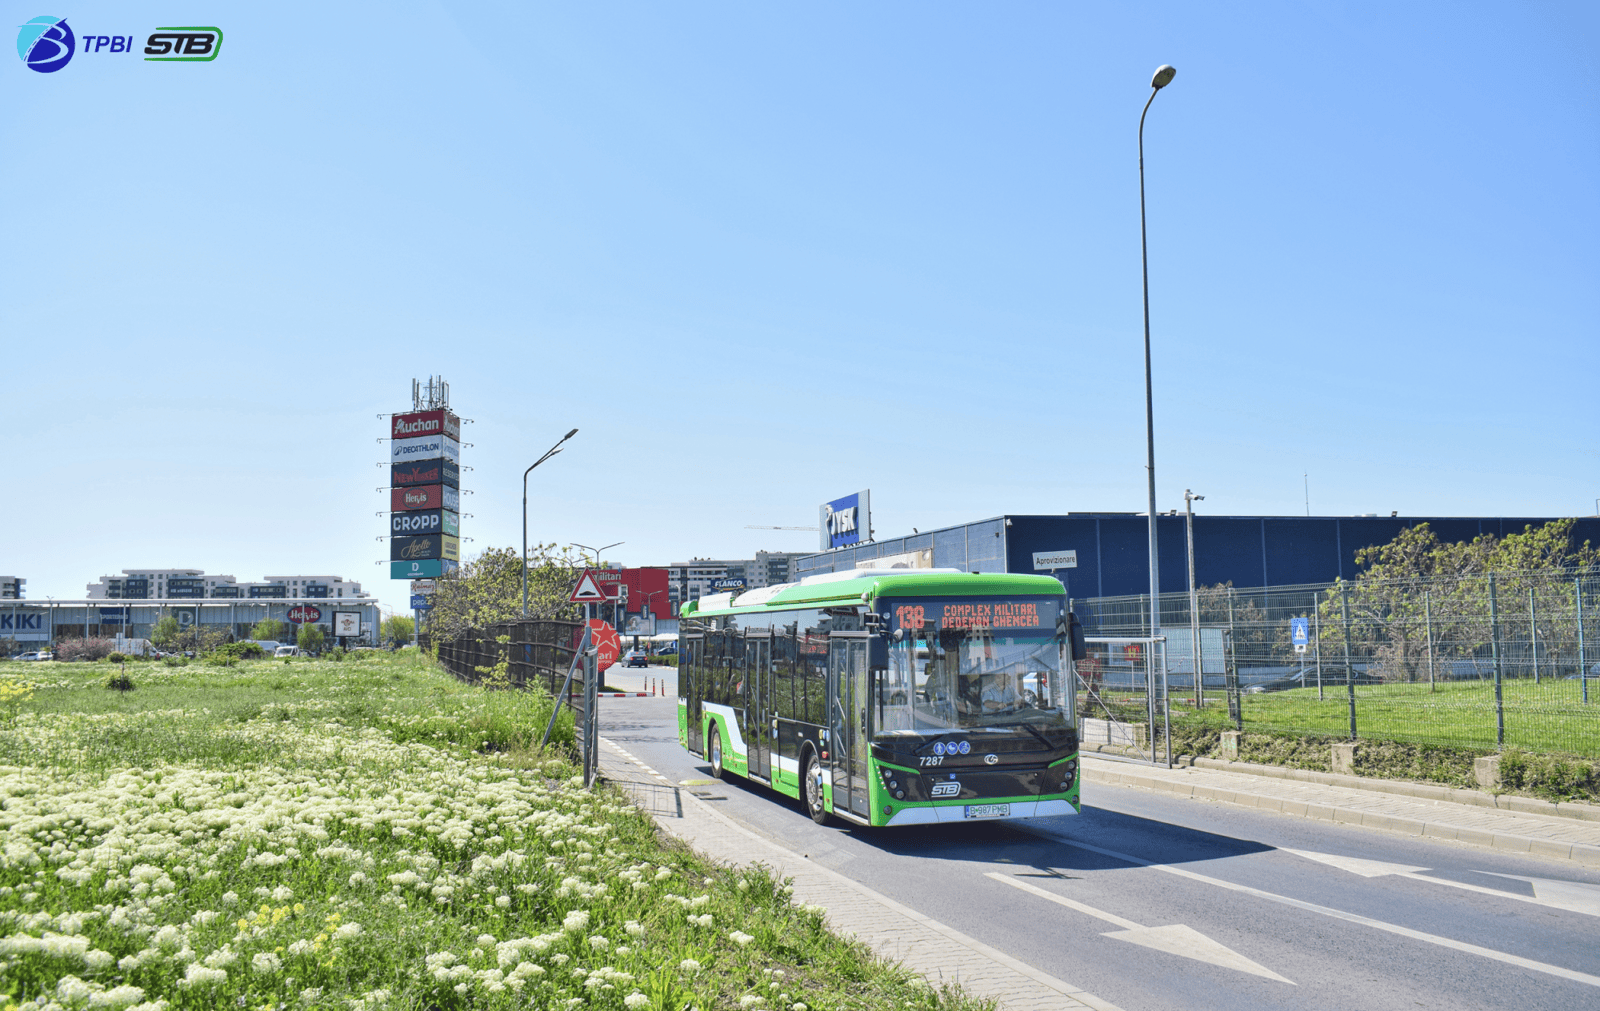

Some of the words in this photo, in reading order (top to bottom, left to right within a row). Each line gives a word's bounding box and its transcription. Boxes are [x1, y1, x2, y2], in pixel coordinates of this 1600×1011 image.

[394, 418, 439, 435] Auchan
[402, 442, 440, 454] DECATHLON
[405, 492, 427, 504] Hervis
[393, 514, 439, 531] CROPP
[831, 506, 857, 535] JYSK
[412, 562, 419, 572] D
[1036, 556, 1076, 566] Aprovizionare
[290, 609, 319, 621] Hervis
[943, 605, 991, 617] COMPLEX
[994, 603, 1037, 616] MILITARI
[896, 605, 925, 629] 138
[941, 616, 990, 629] DEDEMAN
[993, 615, 1039, 627] GHENCEA
[920, 756, 944, 766] 7287
[931, 784, 958, 795] STB
[970, 807, 976, 815] B
[979, 805, 991, 815] 987
[992, 804, 1008, 813] PMB
